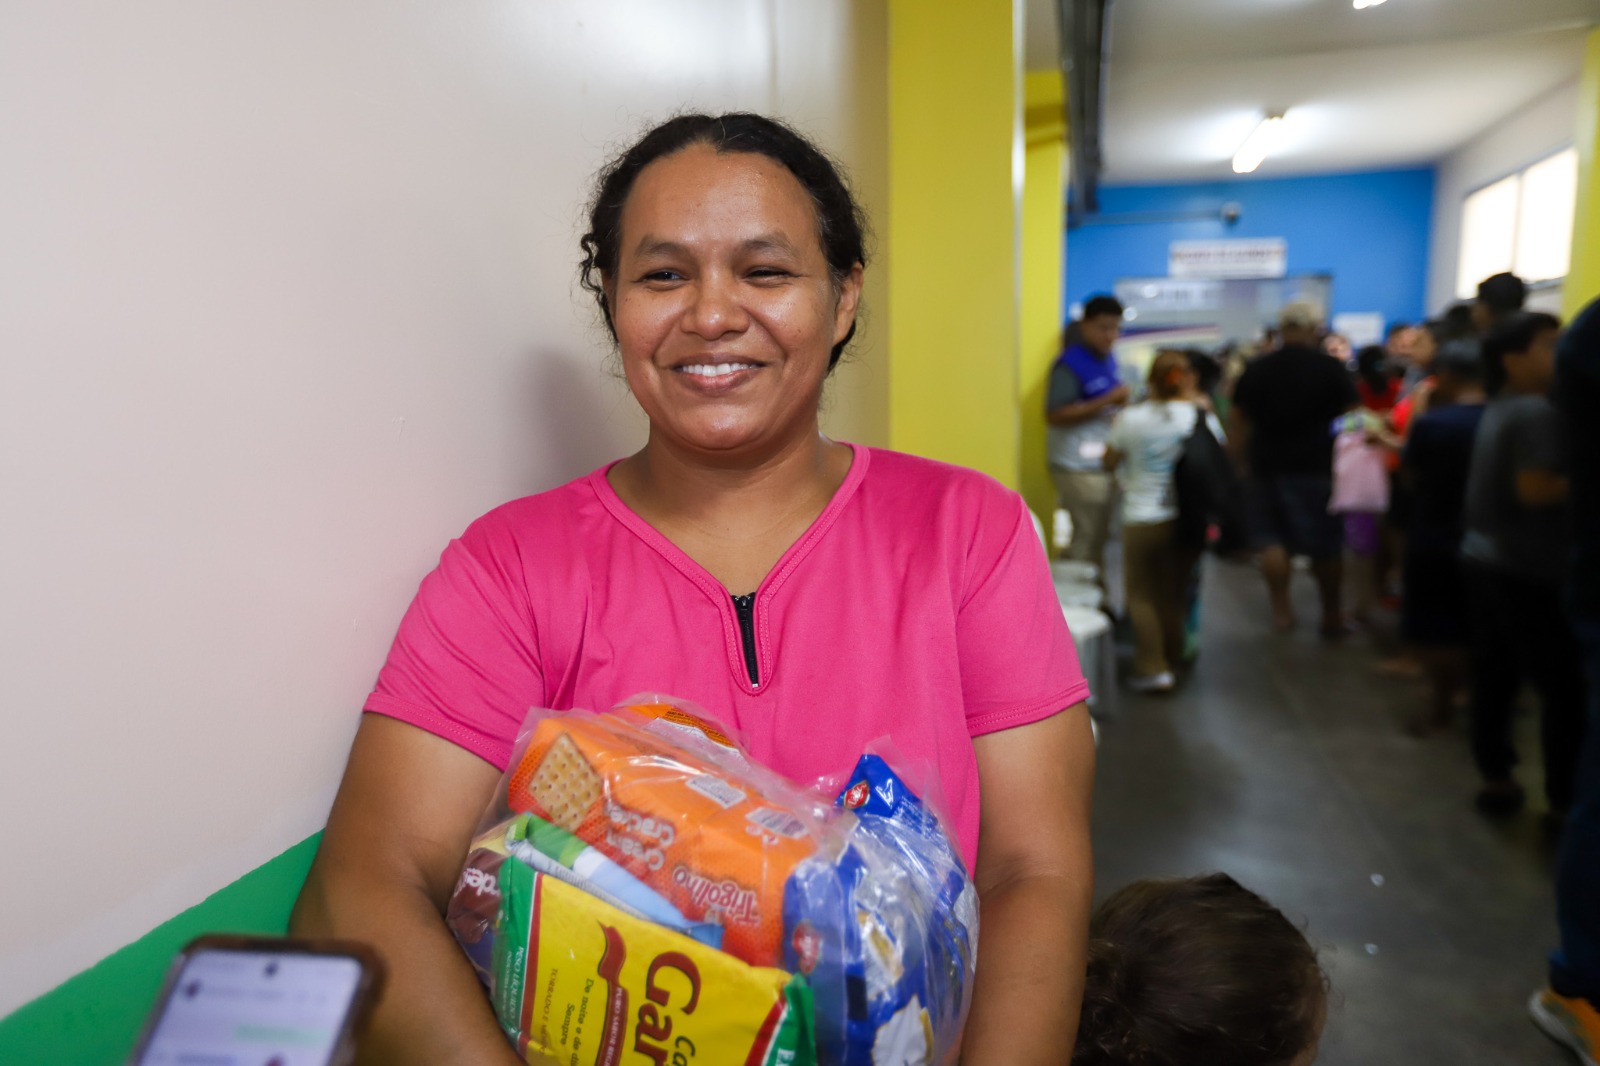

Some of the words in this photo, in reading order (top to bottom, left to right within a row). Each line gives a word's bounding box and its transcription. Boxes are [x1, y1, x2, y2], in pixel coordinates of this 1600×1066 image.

[606, 837, 666, 872] Cream
[672, 866, 761, 928] Trigolino
[514, 946, 525, 971] PESO
[543, 968, 558, 1014] TORRADO
[584, 978, 594, 993] De
[614, 987, 623, 1014] PURO
[560, 1003, 575, 1045] Sempre
[578, 996, 589, 1024] noite
[573, 1037, 582, 1050] de
[609, 1015, 619, 1045] SABOR
[672, 1036, 696, 1066] Ca
